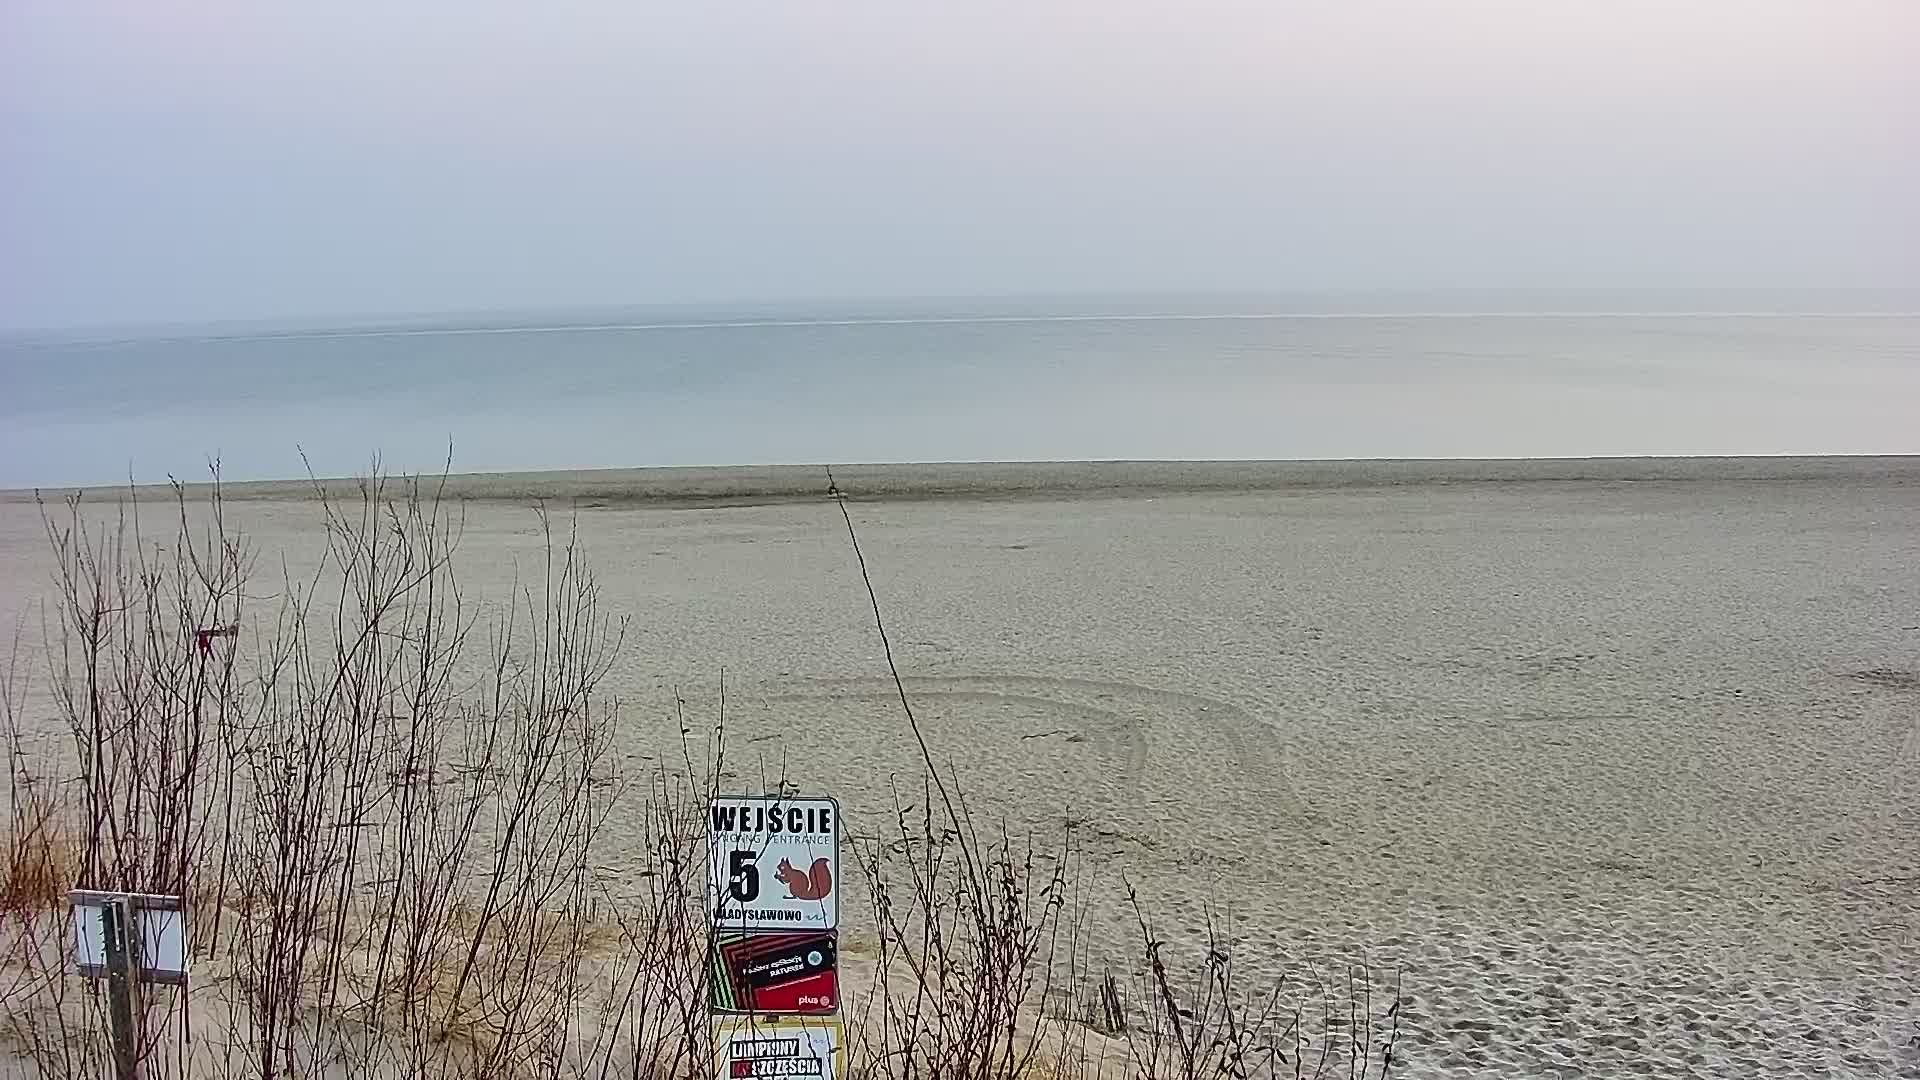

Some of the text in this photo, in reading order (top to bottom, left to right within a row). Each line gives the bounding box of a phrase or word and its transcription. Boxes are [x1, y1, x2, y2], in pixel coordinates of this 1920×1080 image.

[712, 802, 831, 833] WEJŚCIE
[774, 834, 829, 844] ENTRANCE
[729, 851, 759, 902] 5
[798, 996, 819, 1006] plus
